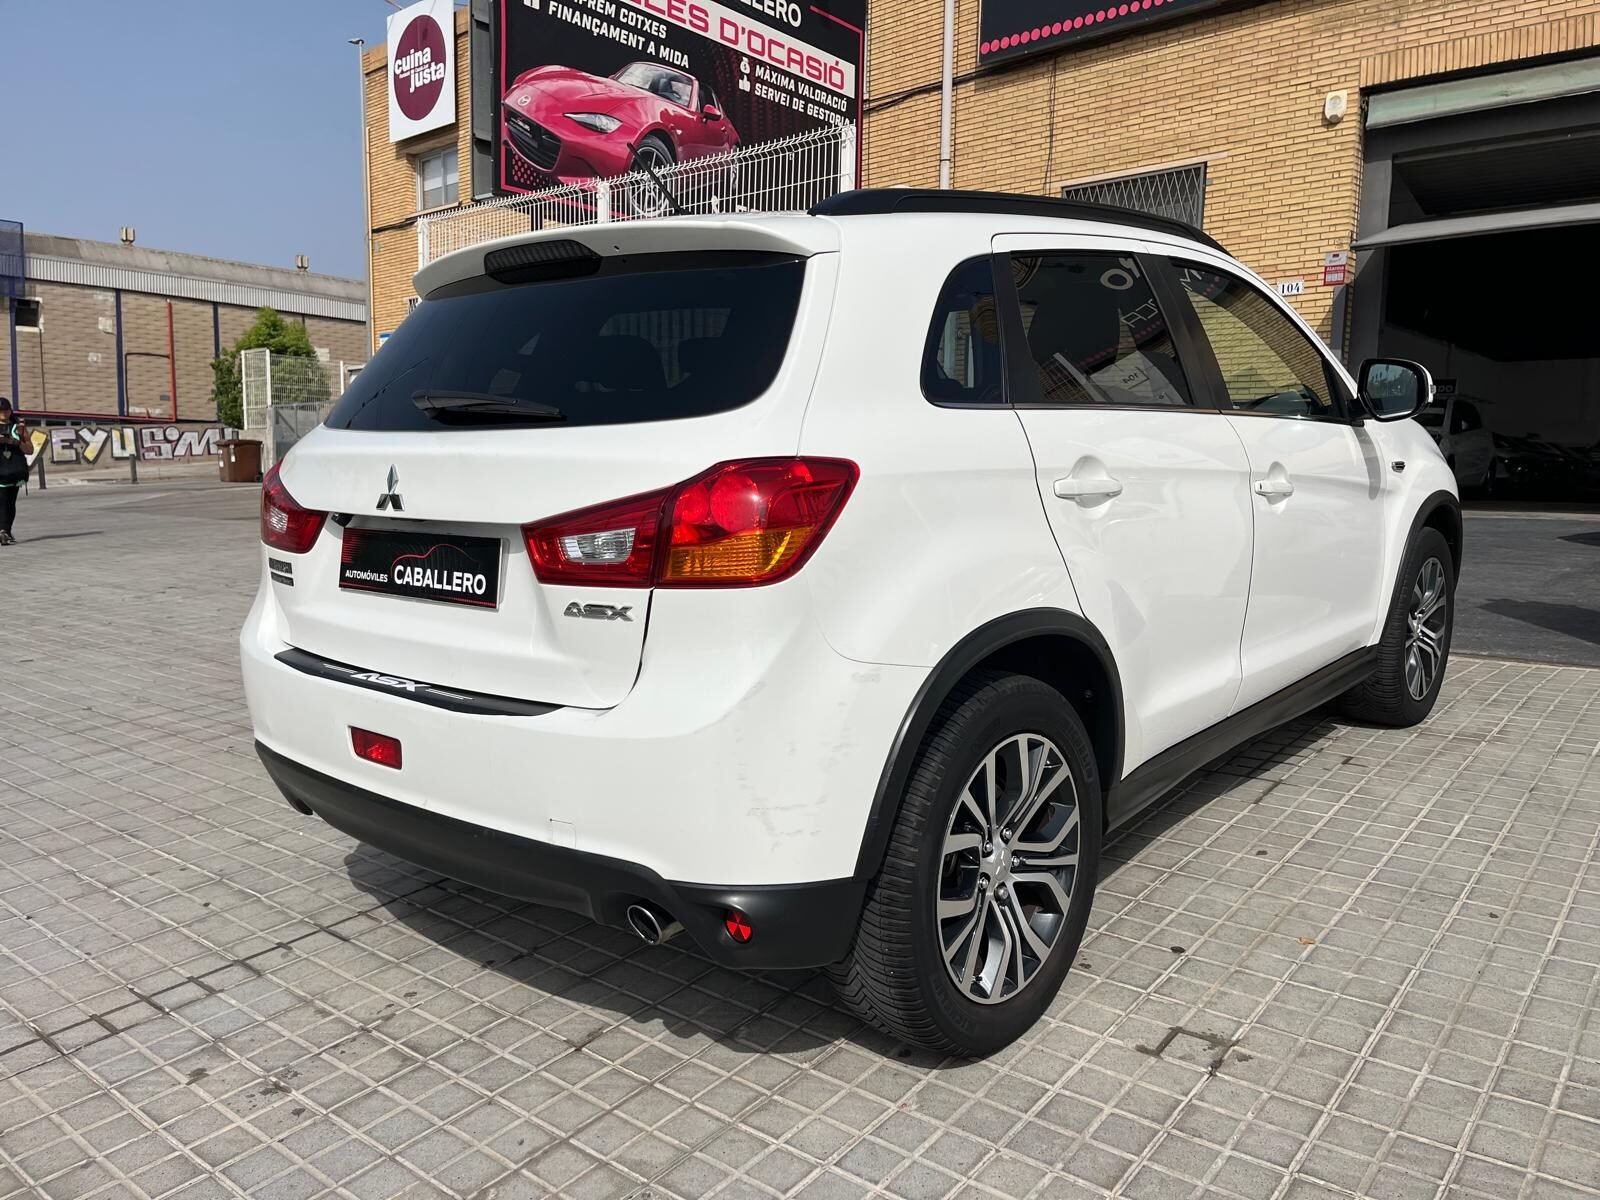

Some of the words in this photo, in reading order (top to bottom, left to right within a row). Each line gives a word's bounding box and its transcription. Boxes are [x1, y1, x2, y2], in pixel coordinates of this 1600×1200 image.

[548, 2, 646, 51] FINANÇAMENT
[647, 40, 656, 56] A
[659, 45, 689, 69] MIDA
[619, 7, 667, 39] COTXES
[394, 46, 432, 75] cuina
[719, 16, 845, 91] D'OCASIÓ
[409, 61, 445, 93] justa
[755, 64, 796, 92] MÀXIMA
[798, 81, 847, 112] VALORACIÓ
[754, 82, 790, 107] SERVEI
[792, 97, 805, 112] DE
[1281, 282, 1300, 294] 104
[345, 569, 389, 583] AUTOMÓVILES
[394, 564, 487, 595] CABALLERO
[563, 601, 635, 622] ASX
[350, 671, 432, 693] ASX
